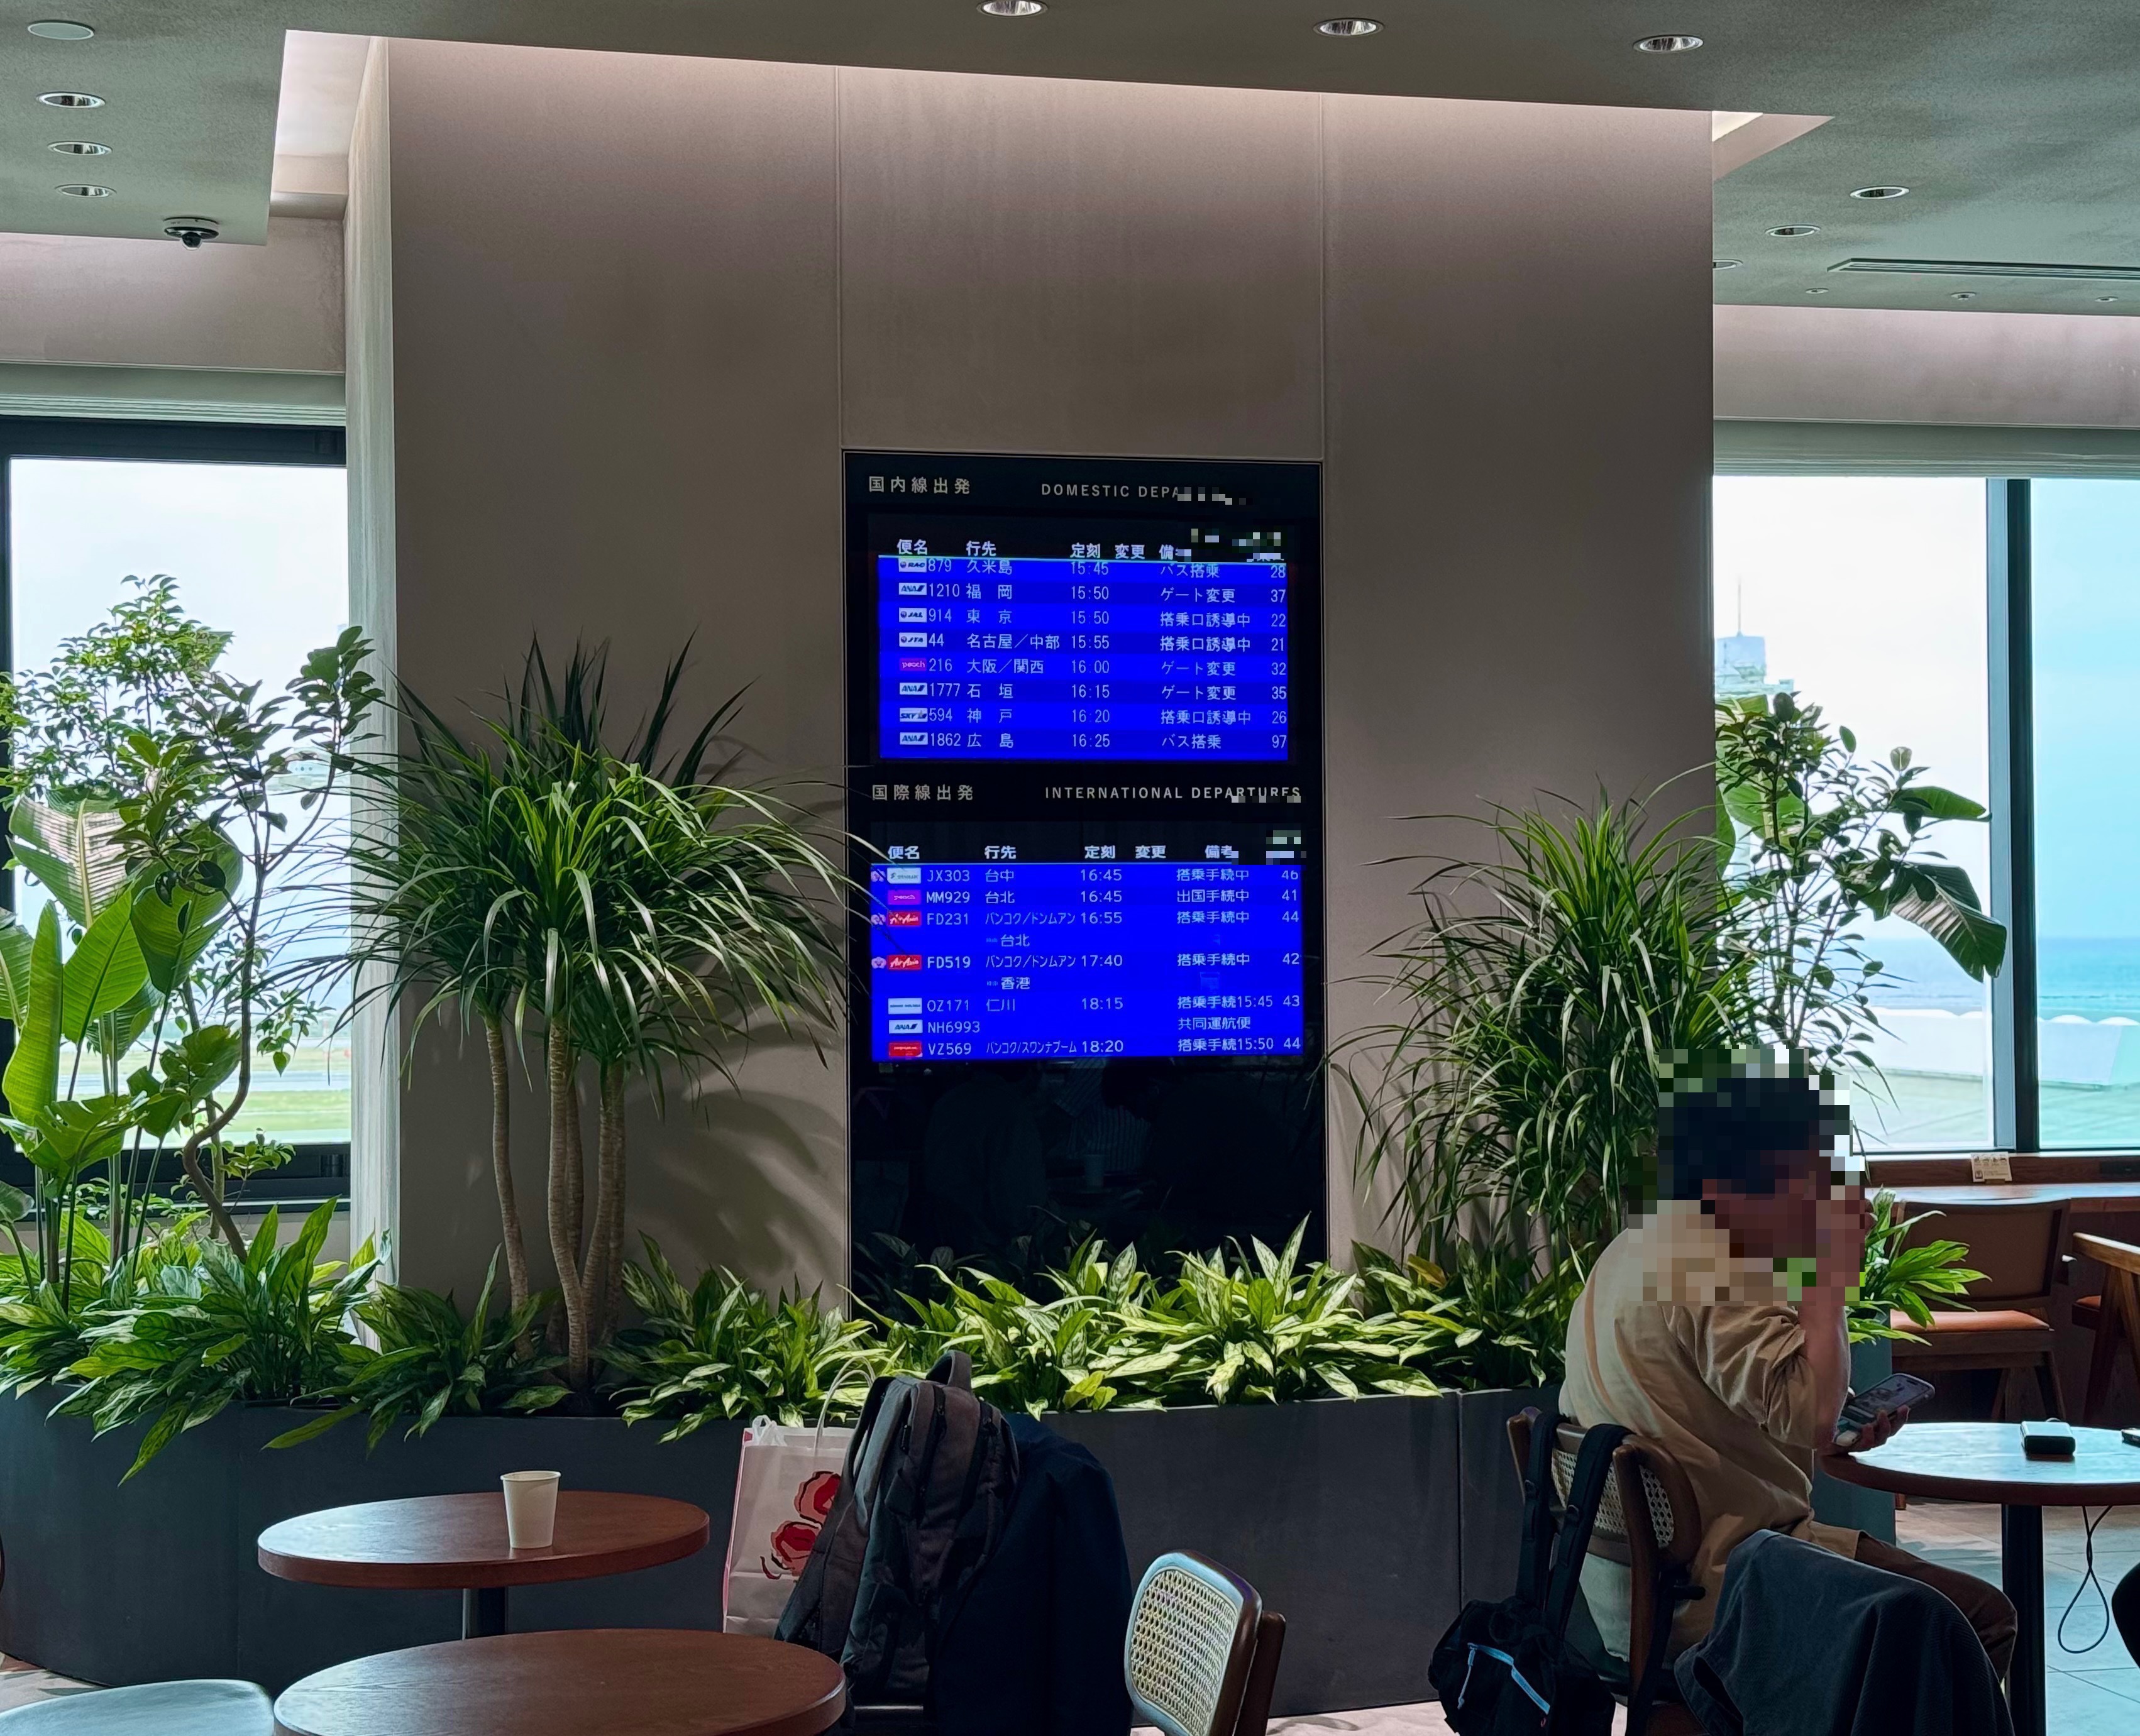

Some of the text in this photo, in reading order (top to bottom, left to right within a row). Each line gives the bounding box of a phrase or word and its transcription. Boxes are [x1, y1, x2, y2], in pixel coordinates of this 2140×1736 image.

[869, 476, 970, 495] 国内線出発
[1042, 483, 1129, 497] DOMESTIC
[896, 539, 928, 555] 便名
[966, 540, 996, 557] 行先
[1069, 543, 1101, 559] 定刻
[1115, 543, 1145, 559] 変更
[928, 559, 952, 573] 879
[966, 559, 1013, 575] 久米島
[1071, 563, 1109, 575] 15:45
[1160, 564, 1220, 579] バス搭乗
[1270, 566, 1286, 578] 28
[929, 583, 960, 597] 1210
[1071, 585, 1109, 600] 15:50
[1161, 586, 1235, 603] ゲート変更
[1271, 589, 1286, 603] 37
[929, 608, 952, 622] 914
[1072, 610, 1110, 625] 15:50
[1160, 611, 1250, 628] 搭乗口誘導中
[1271, 613, 1286, 627] 22
[928, 632, 944, 647] 44
[1071, 635, 1110, 649] 15:55
[1159, 635, 1250, 652] 搭乗口誘導中
[1271, 637, 1284, 652] 21
[929, 657, 952, 672] 216
[1072, 659, 1110, 674] 16:00
[1161, 661, 1236, 676] ゲート変更
[1271, 662, 1286, 676] 32
[930, 682, 961, 697] 1777
[1071, 684, 1110, 698] 16:15
[1161, 684, 1237, 701] ゲート変更
[1271, 686, 1287, 700] 35
[929, 707, 953, 722] 594
[1073, 709, 1110, 723] 16:20
[1161, 709, 1251, 725] 搭乗口誘導中
[1272, 710, 1287, 724] 26
[930, 732, 961, 747] 1862
[1073, 733, 1110, 747] 16:25
[1162, 733, 1222, 749] バス搭乗
[1272, 734, 1287, 749] 97
[872, 784, 973, 801] 国際線出発
[1045, 787, 1301, 799] INTERNATIONAL DEPARTURES
[887, 845, 920, 860] 便名
[984, 845, 1017, 859] 行先
[1084, 845, 1116, 859] 定刻
[1135, 845, 1166, 859] 変更
[927, 869, 970, 882] JX303
[985, 869, 1014, 882] 台中
[1080, 869, 1122, 881] 16:45
[1281, 870, 1299, 880] 46
[926, 891, 970, 904] MM929
[985, 890, 1015, 904] 台北
[1081, 890, 1122, 903] 16:45
[1177, 889, 1249, 903] 出国手続中
[1281, 889, 1297, 901] 41
[927, 913, 968, 925] FD231
[1081, 911, 1122, 924] 16:55
[1177, 910, 1249, 924] 搭乗手続中
[1281, 910, 1299, 922] 44
[1000, 933, 1030, 947] 台北
[927, 955, 971, 969] FD519
[1081, 954, 1123, 967] 17:40
[1177, 952, 1250, 967] 搭乗手続中
[1282, 952, 1299, 965] 42
[1001, 976, 1030, 990] 香港
[927, 999, 969, 1012] OZ171
[986, 999, 1015, 1012] 仁川
[1082, 997, 1123, 1010] 18:15
[1282, 994, 1300, 1007] 43
[927, 1021, 980, 1033] NH6993
[1178, 1016, 1251, 1030] 共同運航便
[928, 1042, 972, 1055] VZ569
[1082, 1040, 1123, 1053] 18:20
[1283, 1036, 1301, 1050] 44
